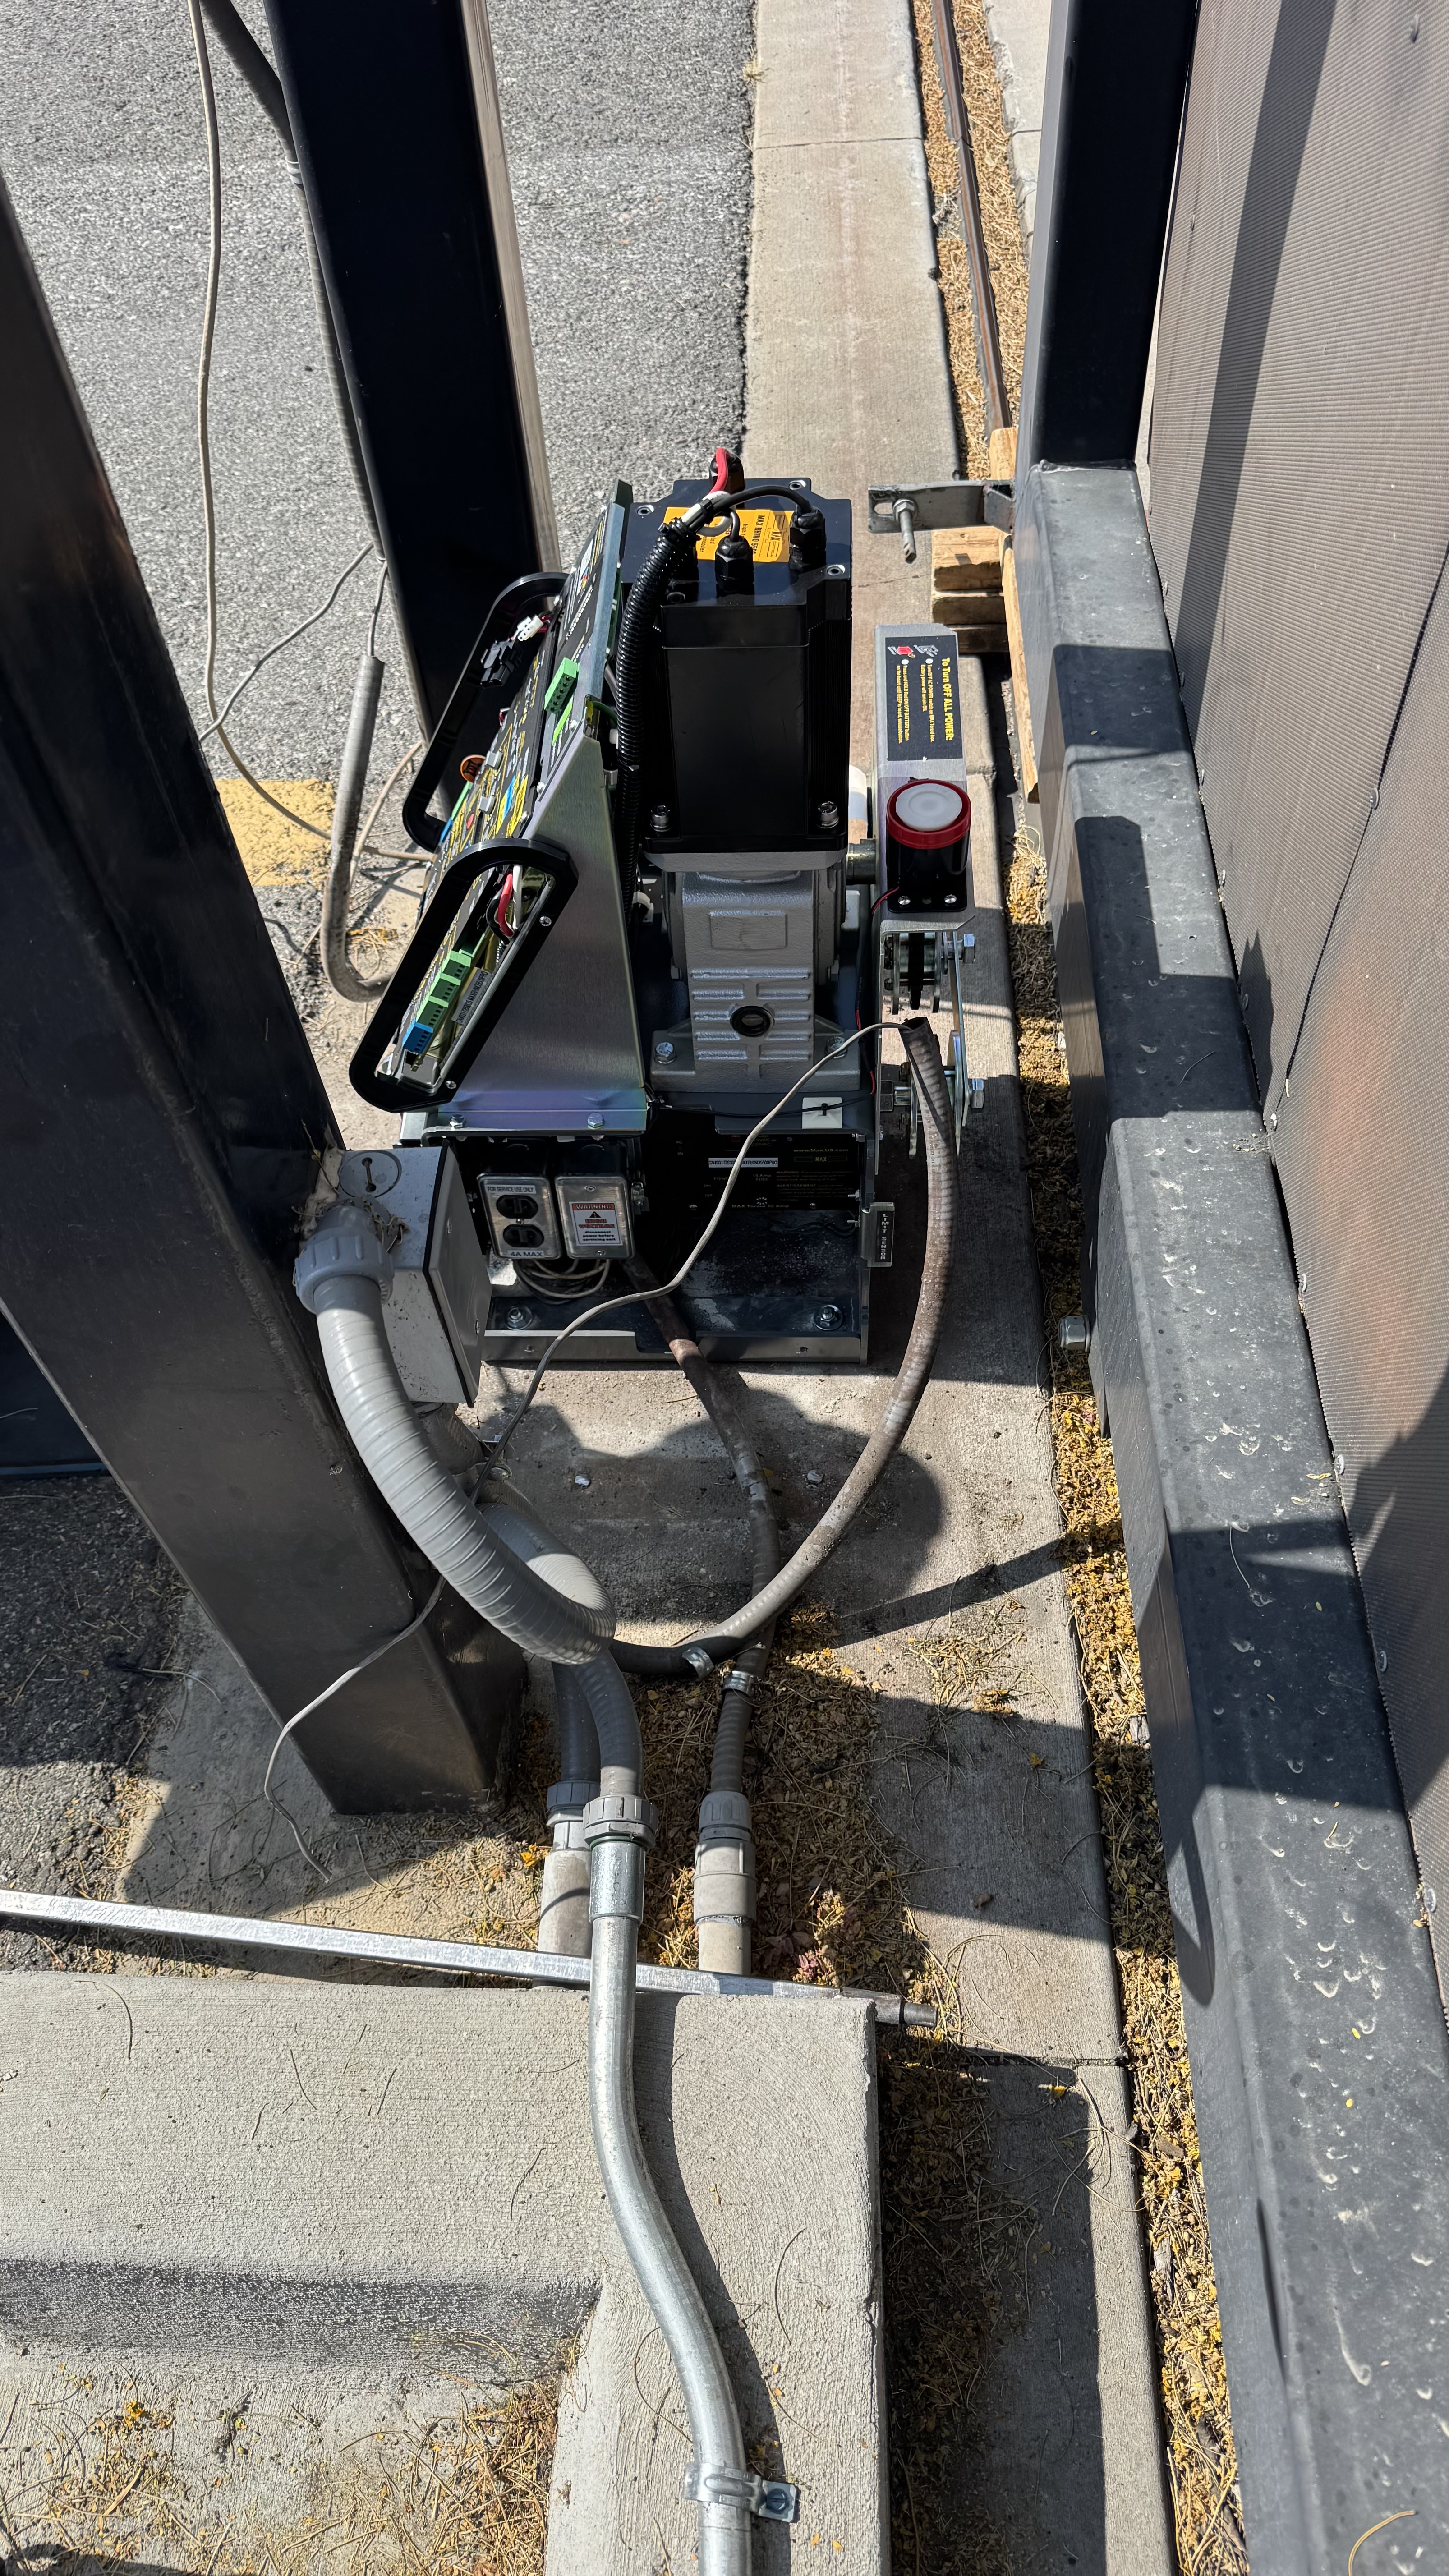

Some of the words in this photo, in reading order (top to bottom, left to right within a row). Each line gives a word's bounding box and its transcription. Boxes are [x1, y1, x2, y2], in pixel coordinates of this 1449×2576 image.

[756, 515, 765, 526] MAX
[752, 527, 762, 542] RHINO
[770, 532, 782, 541] MAX
[942, 658, 950, 667] To
[942, 667, 951, 683] Turn
[943, 684, 952, 698] OFF
[944, 699, 952, 712] ALL
[945, 713, 954, 741] POWER:
